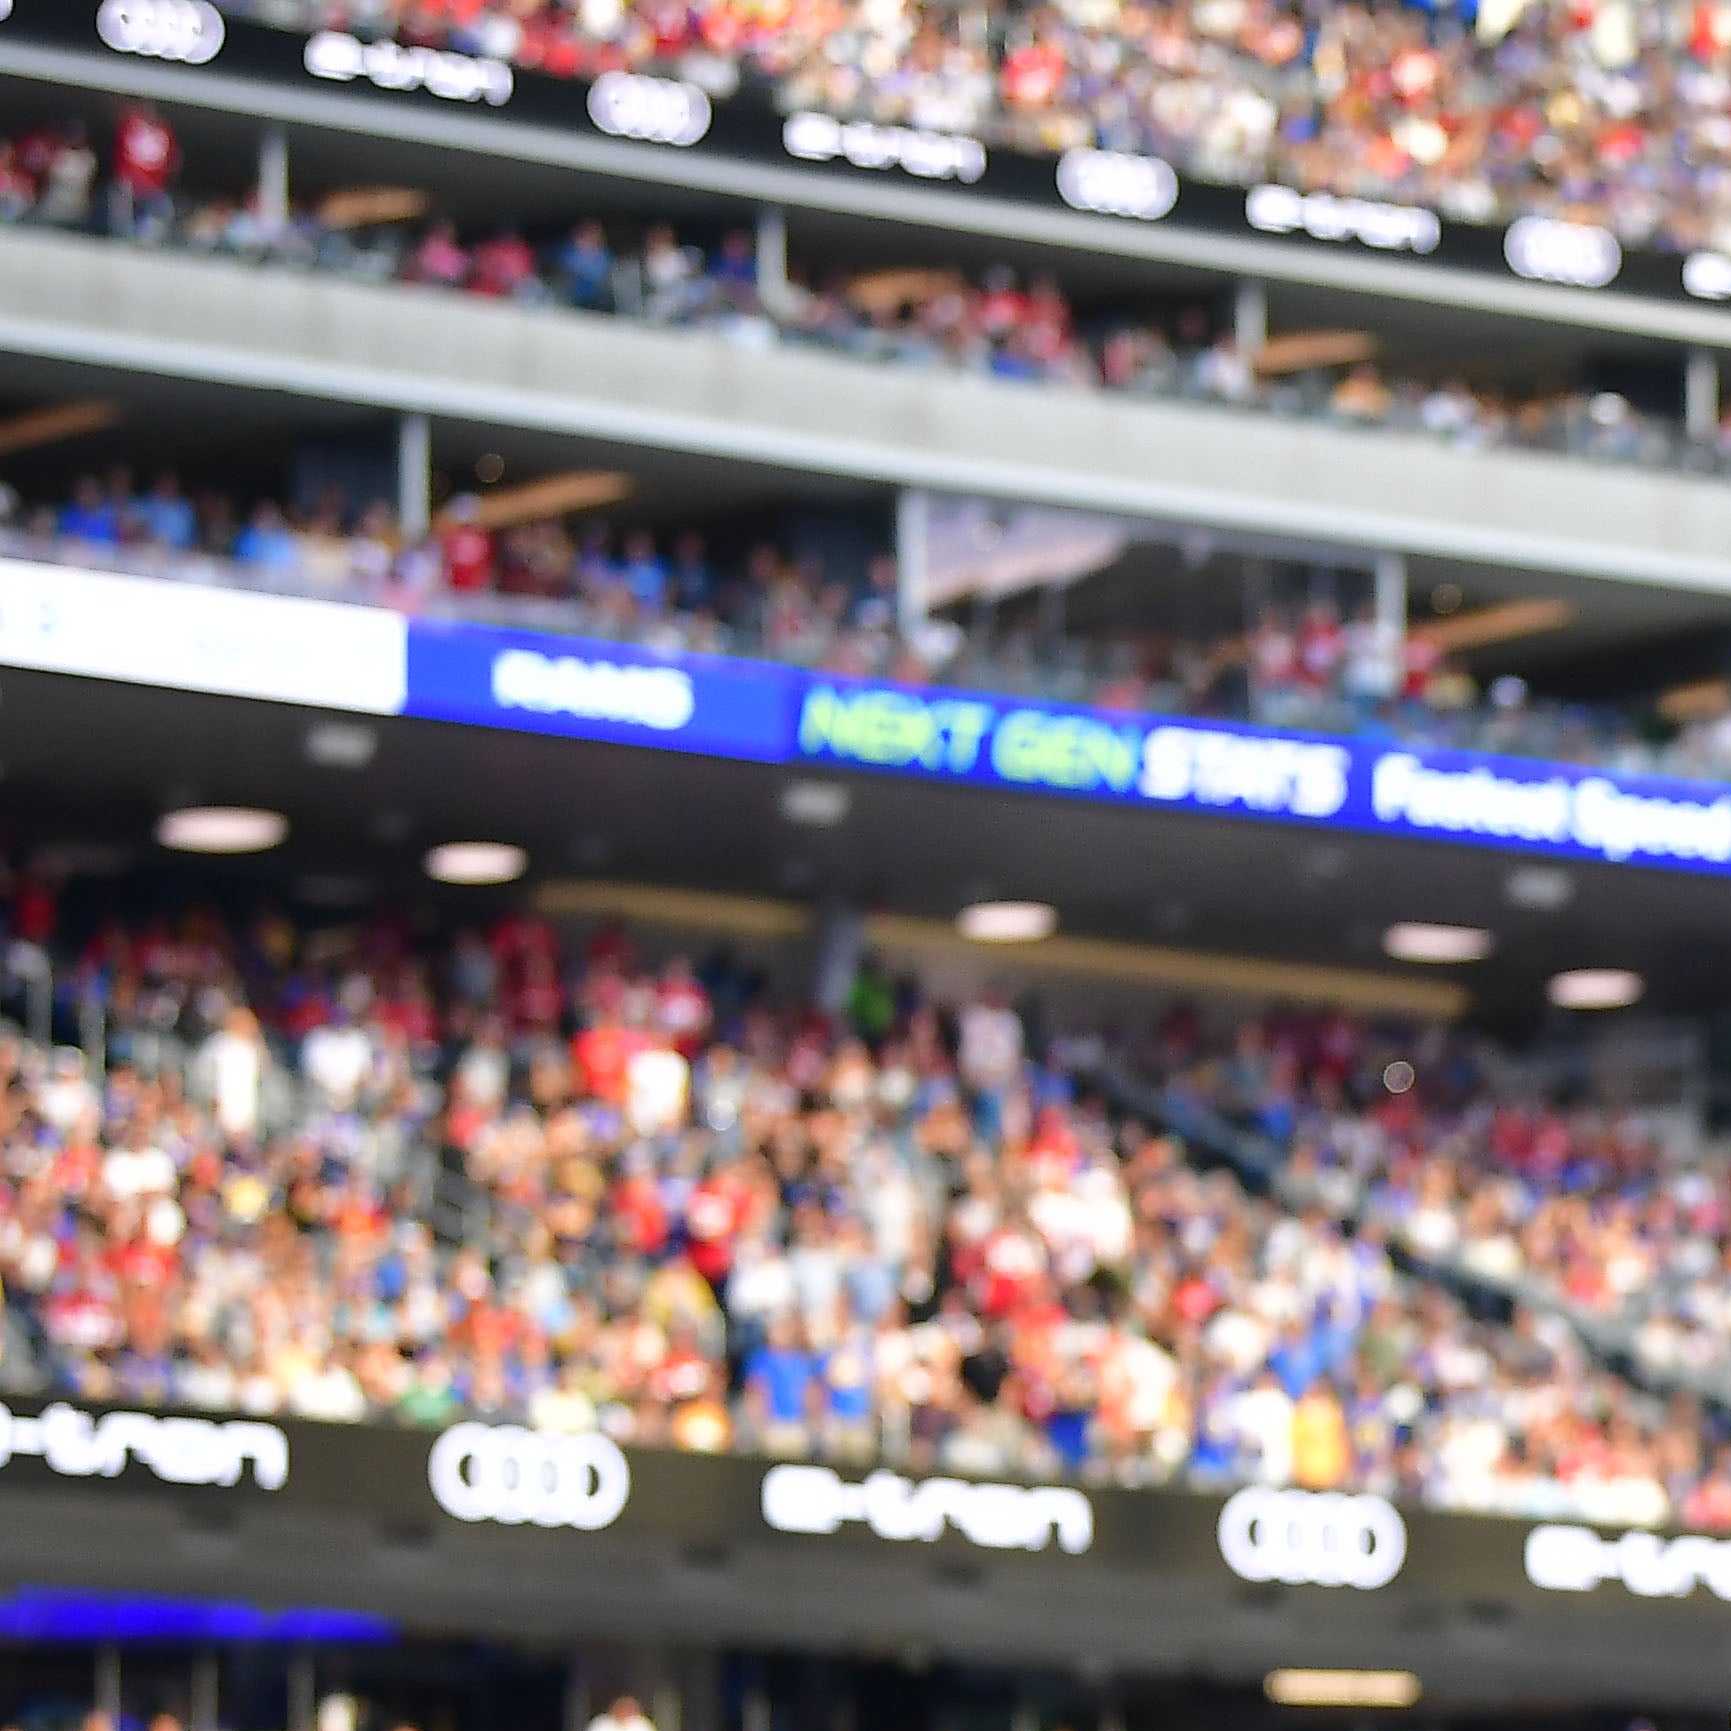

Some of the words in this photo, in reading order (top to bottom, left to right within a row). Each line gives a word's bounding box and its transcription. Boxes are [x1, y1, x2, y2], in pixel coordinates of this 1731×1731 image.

[801, 684, 994, 773] NEXT
[991, 707, 1142, 793] GEN
[1139, 724, 1350, 817] STATS
[0, 1402, 289, 1491] -tron
[761, 1464, 1093, 1554] e-tron
